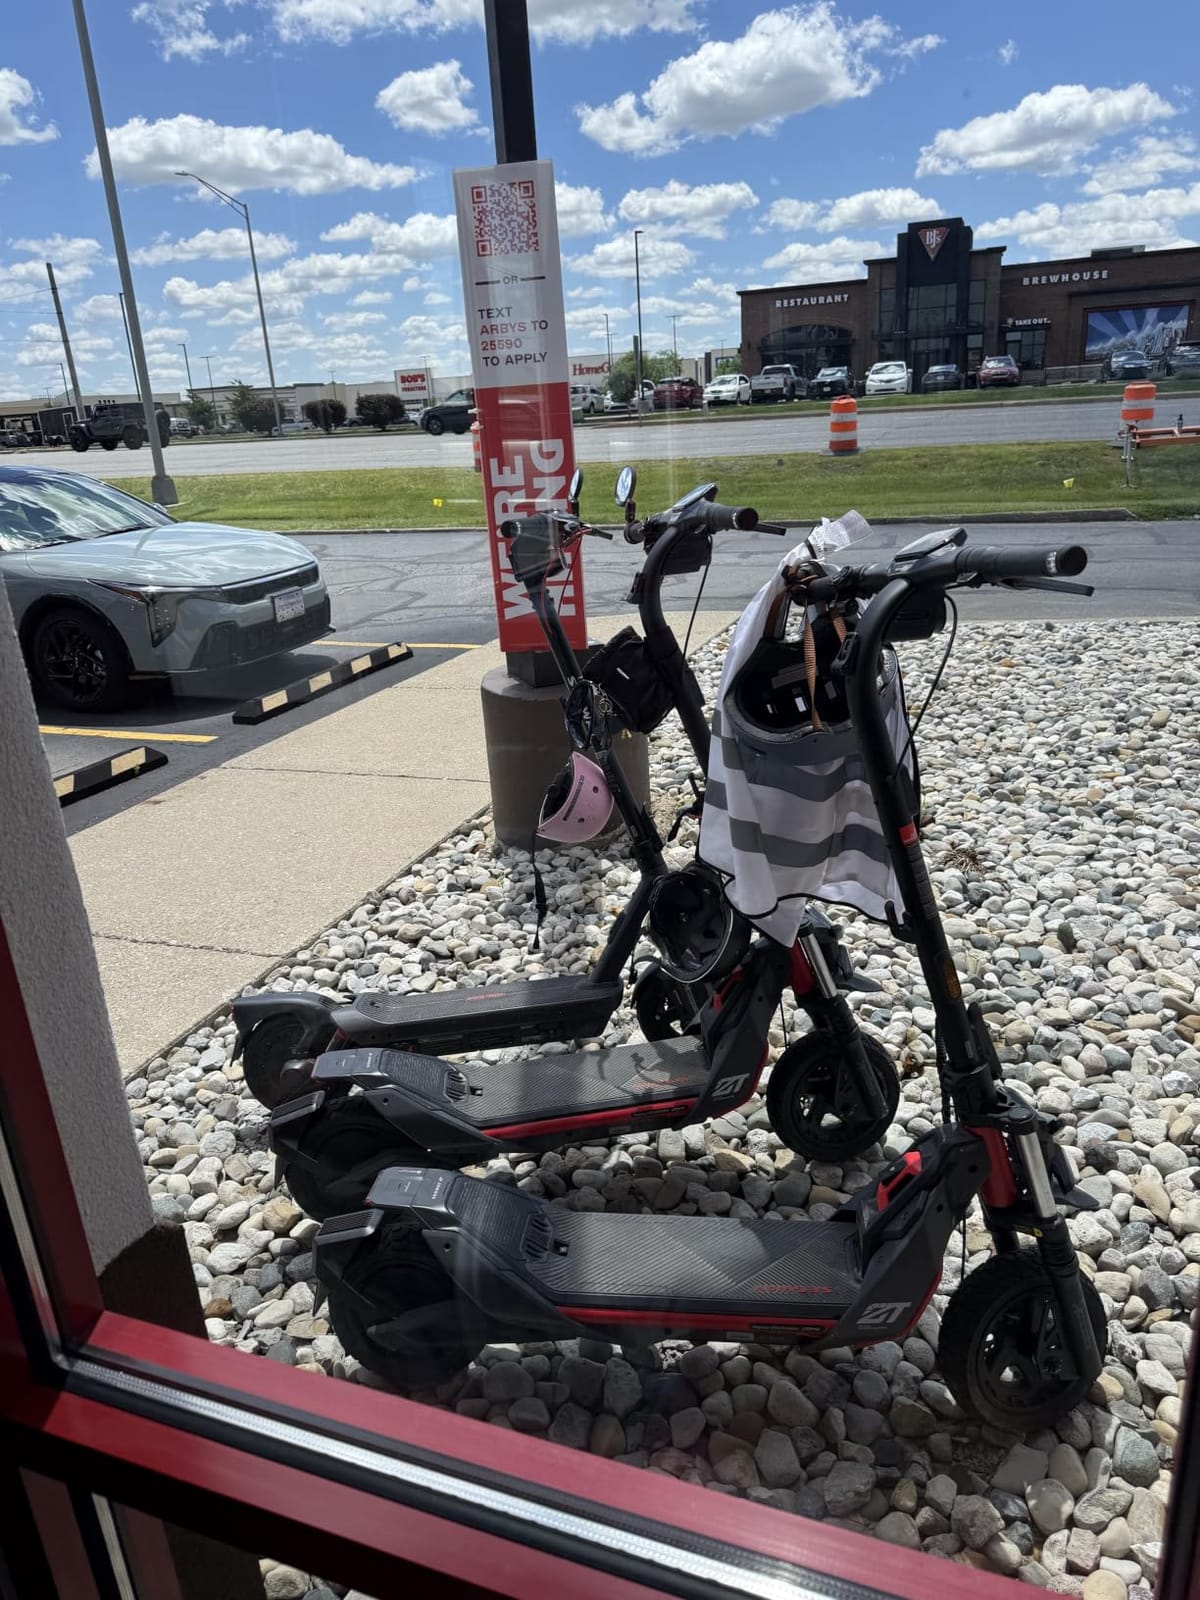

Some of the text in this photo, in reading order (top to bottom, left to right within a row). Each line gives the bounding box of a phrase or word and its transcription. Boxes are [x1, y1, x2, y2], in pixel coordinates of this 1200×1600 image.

[502, 275, 519, 285] OR
[1022, 269, 1109, 286] BREWHOUSE
[775, 293, 849, 308] RESTAURANT
[477, 306, 513, 320] TEXT
[480, 319, 549, 336] ARBYS TO
[481, 338, 523, 352] 25590
[482, 351, 548, 367] TO APPLY
[573, 361, 609, 376] HomeG
[490, 455, 534, 620] WRE
